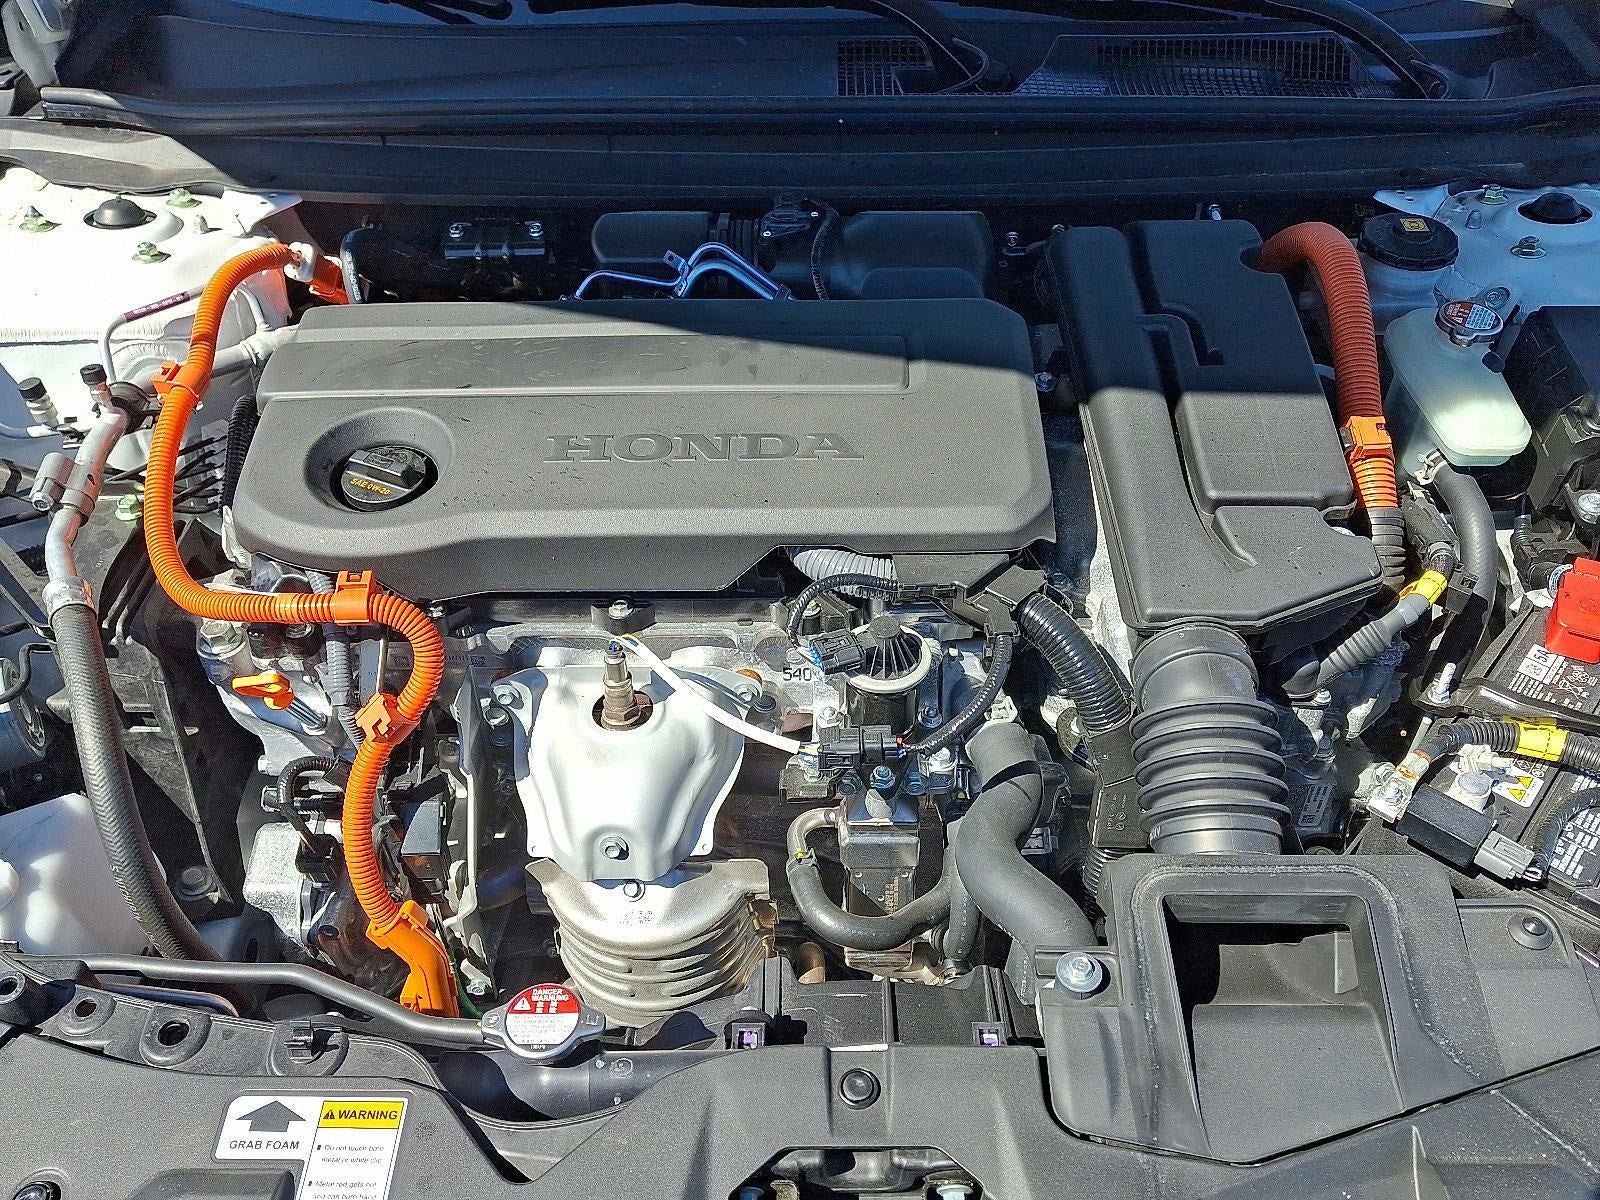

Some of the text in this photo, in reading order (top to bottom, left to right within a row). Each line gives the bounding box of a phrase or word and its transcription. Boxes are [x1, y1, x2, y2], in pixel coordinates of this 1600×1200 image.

[543, 432, 865, 463] HONDA
[350, 478, 392, 496] SAE 0W-20
[782, 667, 812, 681] 540
[532, 988, 563, 996] DANGER
[338, 1109, 398, 1120] WARNING
[229, 1140, 300, 1150] GRAB FOAM
